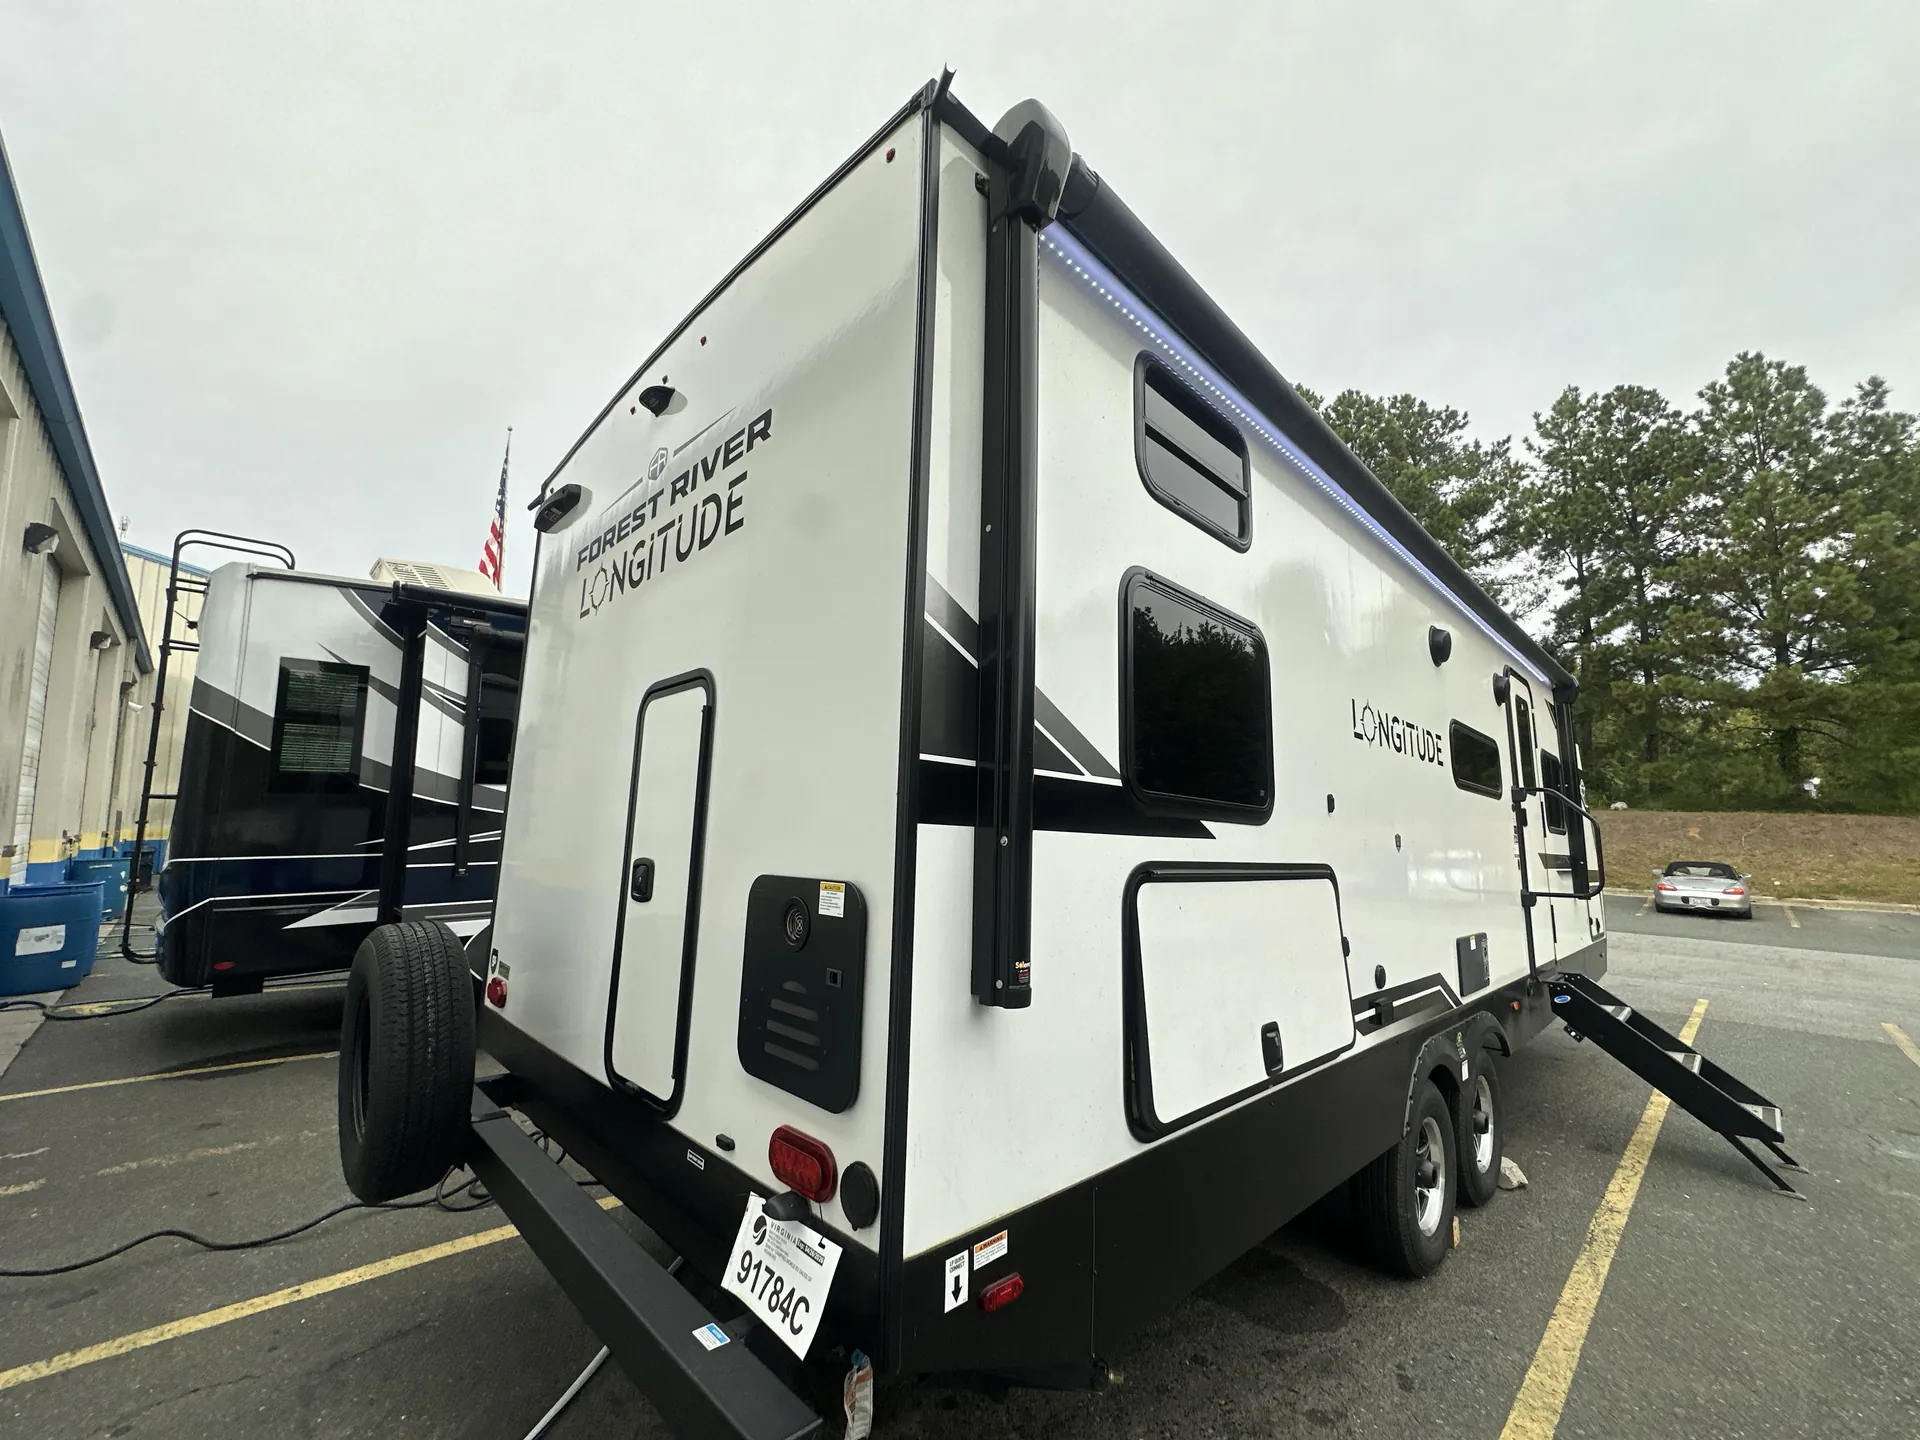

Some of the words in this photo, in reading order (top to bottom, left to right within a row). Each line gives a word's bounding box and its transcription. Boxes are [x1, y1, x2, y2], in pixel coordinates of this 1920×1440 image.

[577, 488, 665, 572] FOREST
[669, 408, 773, 507] RIVER
[579, 470, 748, 620] LONGITUDE
[1351, 698, 1444, 767] LONGITUDE
[770, 1221, 797, 1246] VIRGINIA
[949, 1261, 965, 1273] CONNECT
[737, 1249, 810, 1336] 91784C
